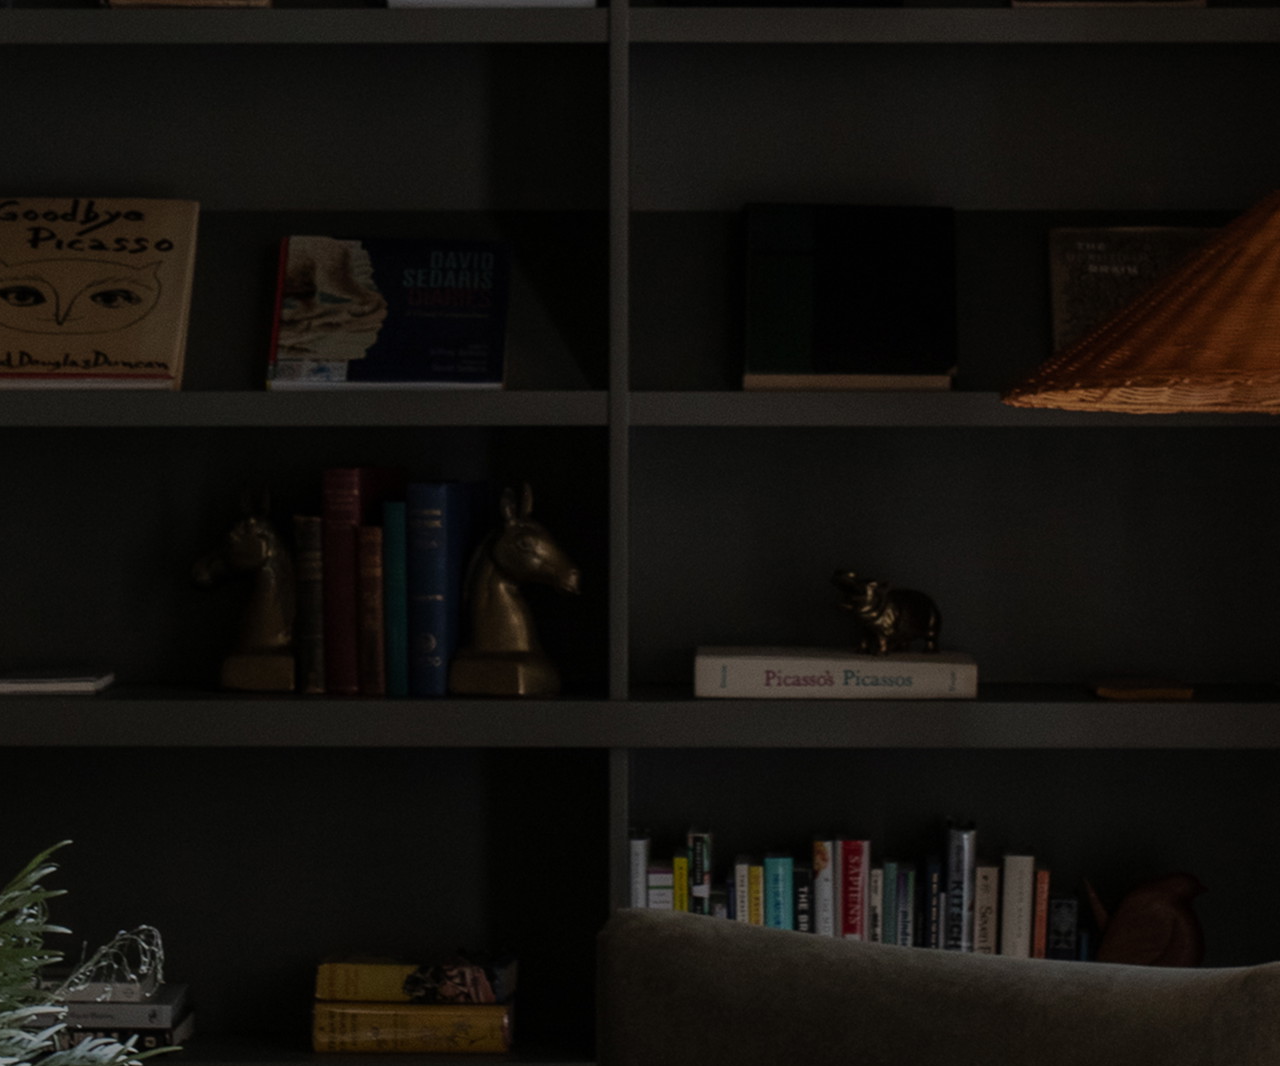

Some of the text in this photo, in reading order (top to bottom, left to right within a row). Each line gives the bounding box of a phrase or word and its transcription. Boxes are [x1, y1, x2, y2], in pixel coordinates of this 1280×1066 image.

[28, 225, 175, 254] Picasso
[429, 250, 495, 271] DAVID
[402, 268, 494, 288] SEDARIS
[18, 350, 91, 371] Douglas
[92, 350, 170, 371] Duncan
[764, 669, 913, 687] Picasso's Picassos
[797, 885, 809, 910] THE
[847, 854, 861, 925] SAPIENS
[948, 880, 963, 950] KITSCH
[977, 905, 993, 944] Seven
